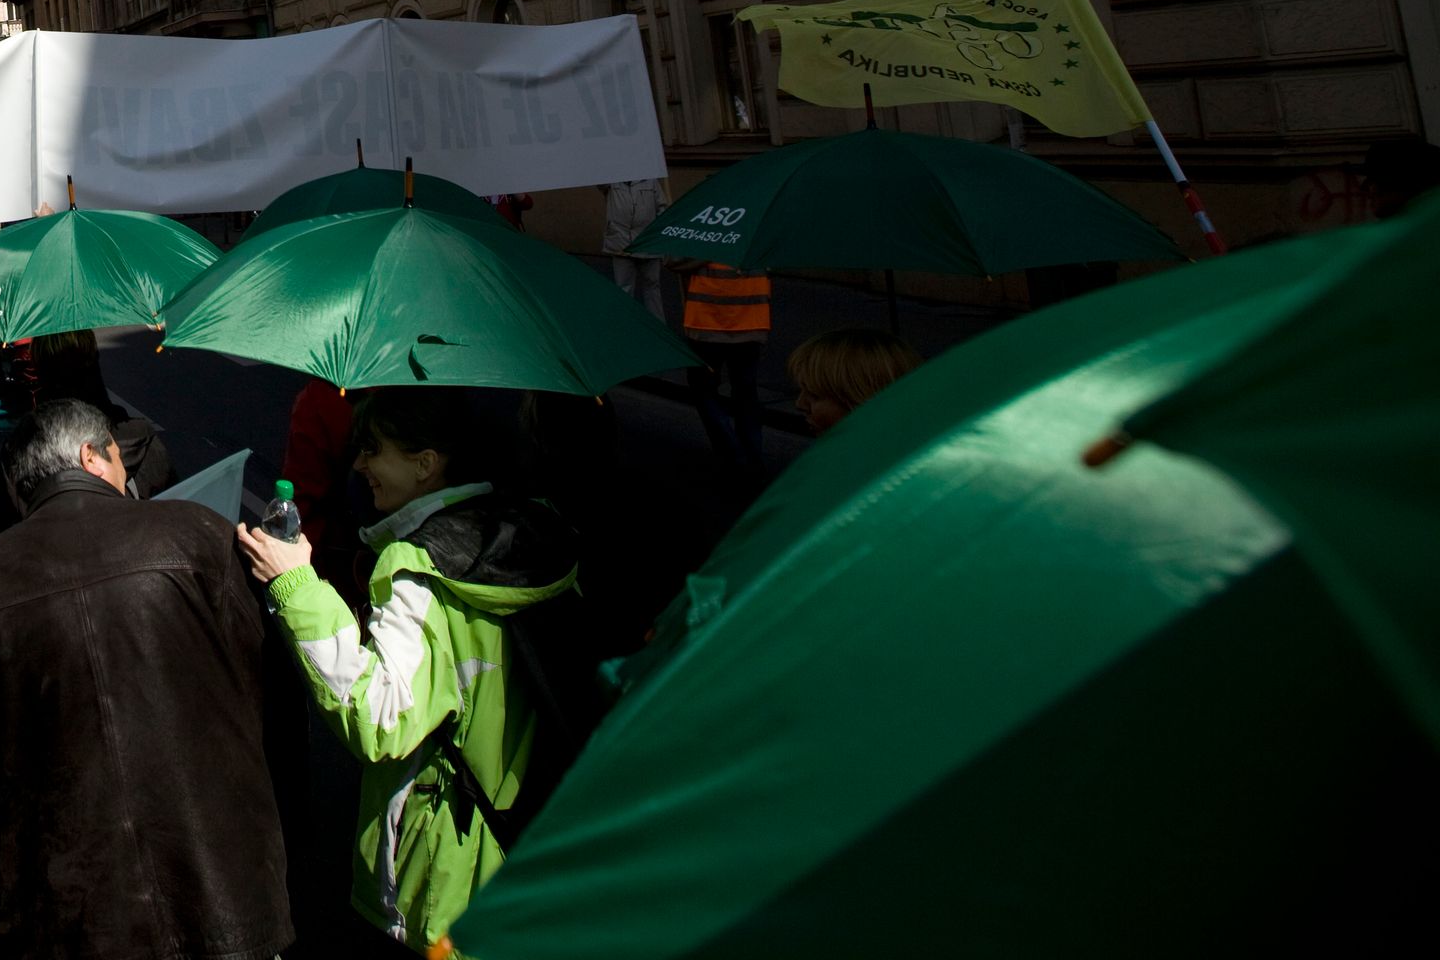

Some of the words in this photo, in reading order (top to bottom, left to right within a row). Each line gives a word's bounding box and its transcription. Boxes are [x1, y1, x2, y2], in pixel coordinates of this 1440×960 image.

[689, 205, 746, 227] ASO
[661, 226, 722, 243] OSPZV-ASO
[721, 231, 742, 244] ČR
